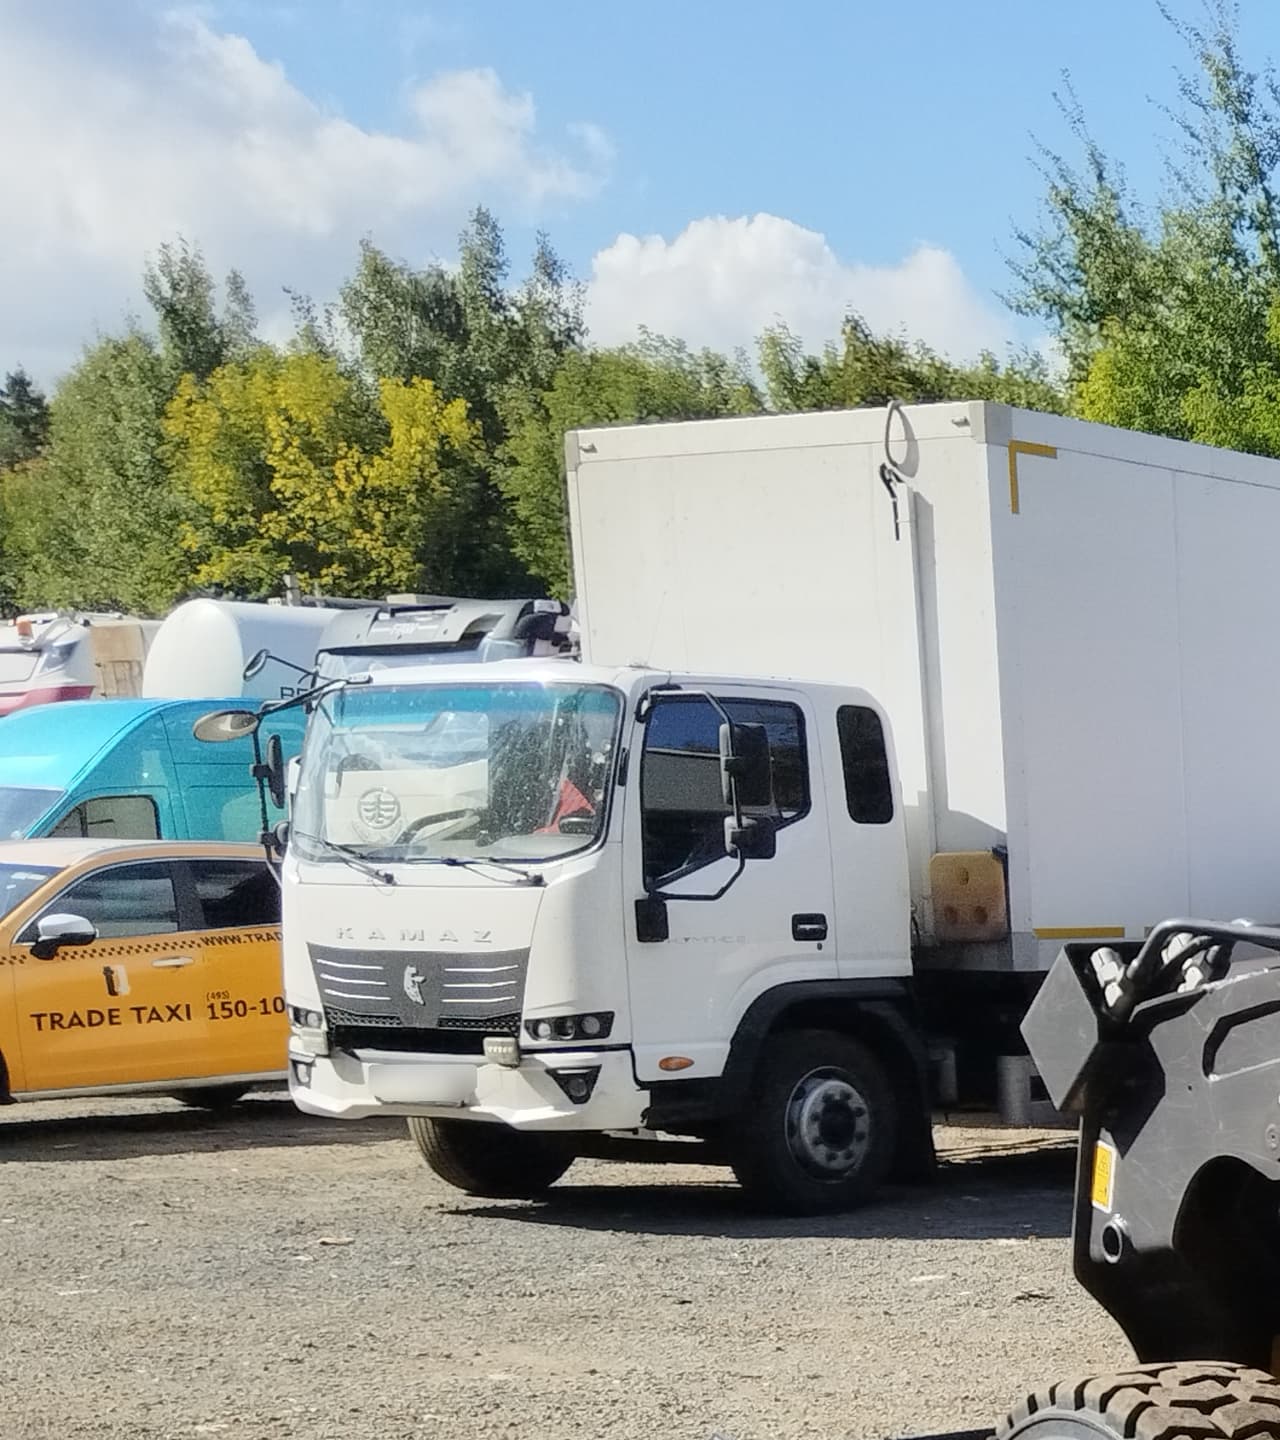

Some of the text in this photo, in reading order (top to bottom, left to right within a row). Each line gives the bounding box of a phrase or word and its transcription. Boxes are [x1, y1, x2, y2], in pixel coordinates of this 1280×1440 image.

[336, 927, 493, 943] KAMAZ
[30, 1003, 193, 1032] TRADE TAXI
